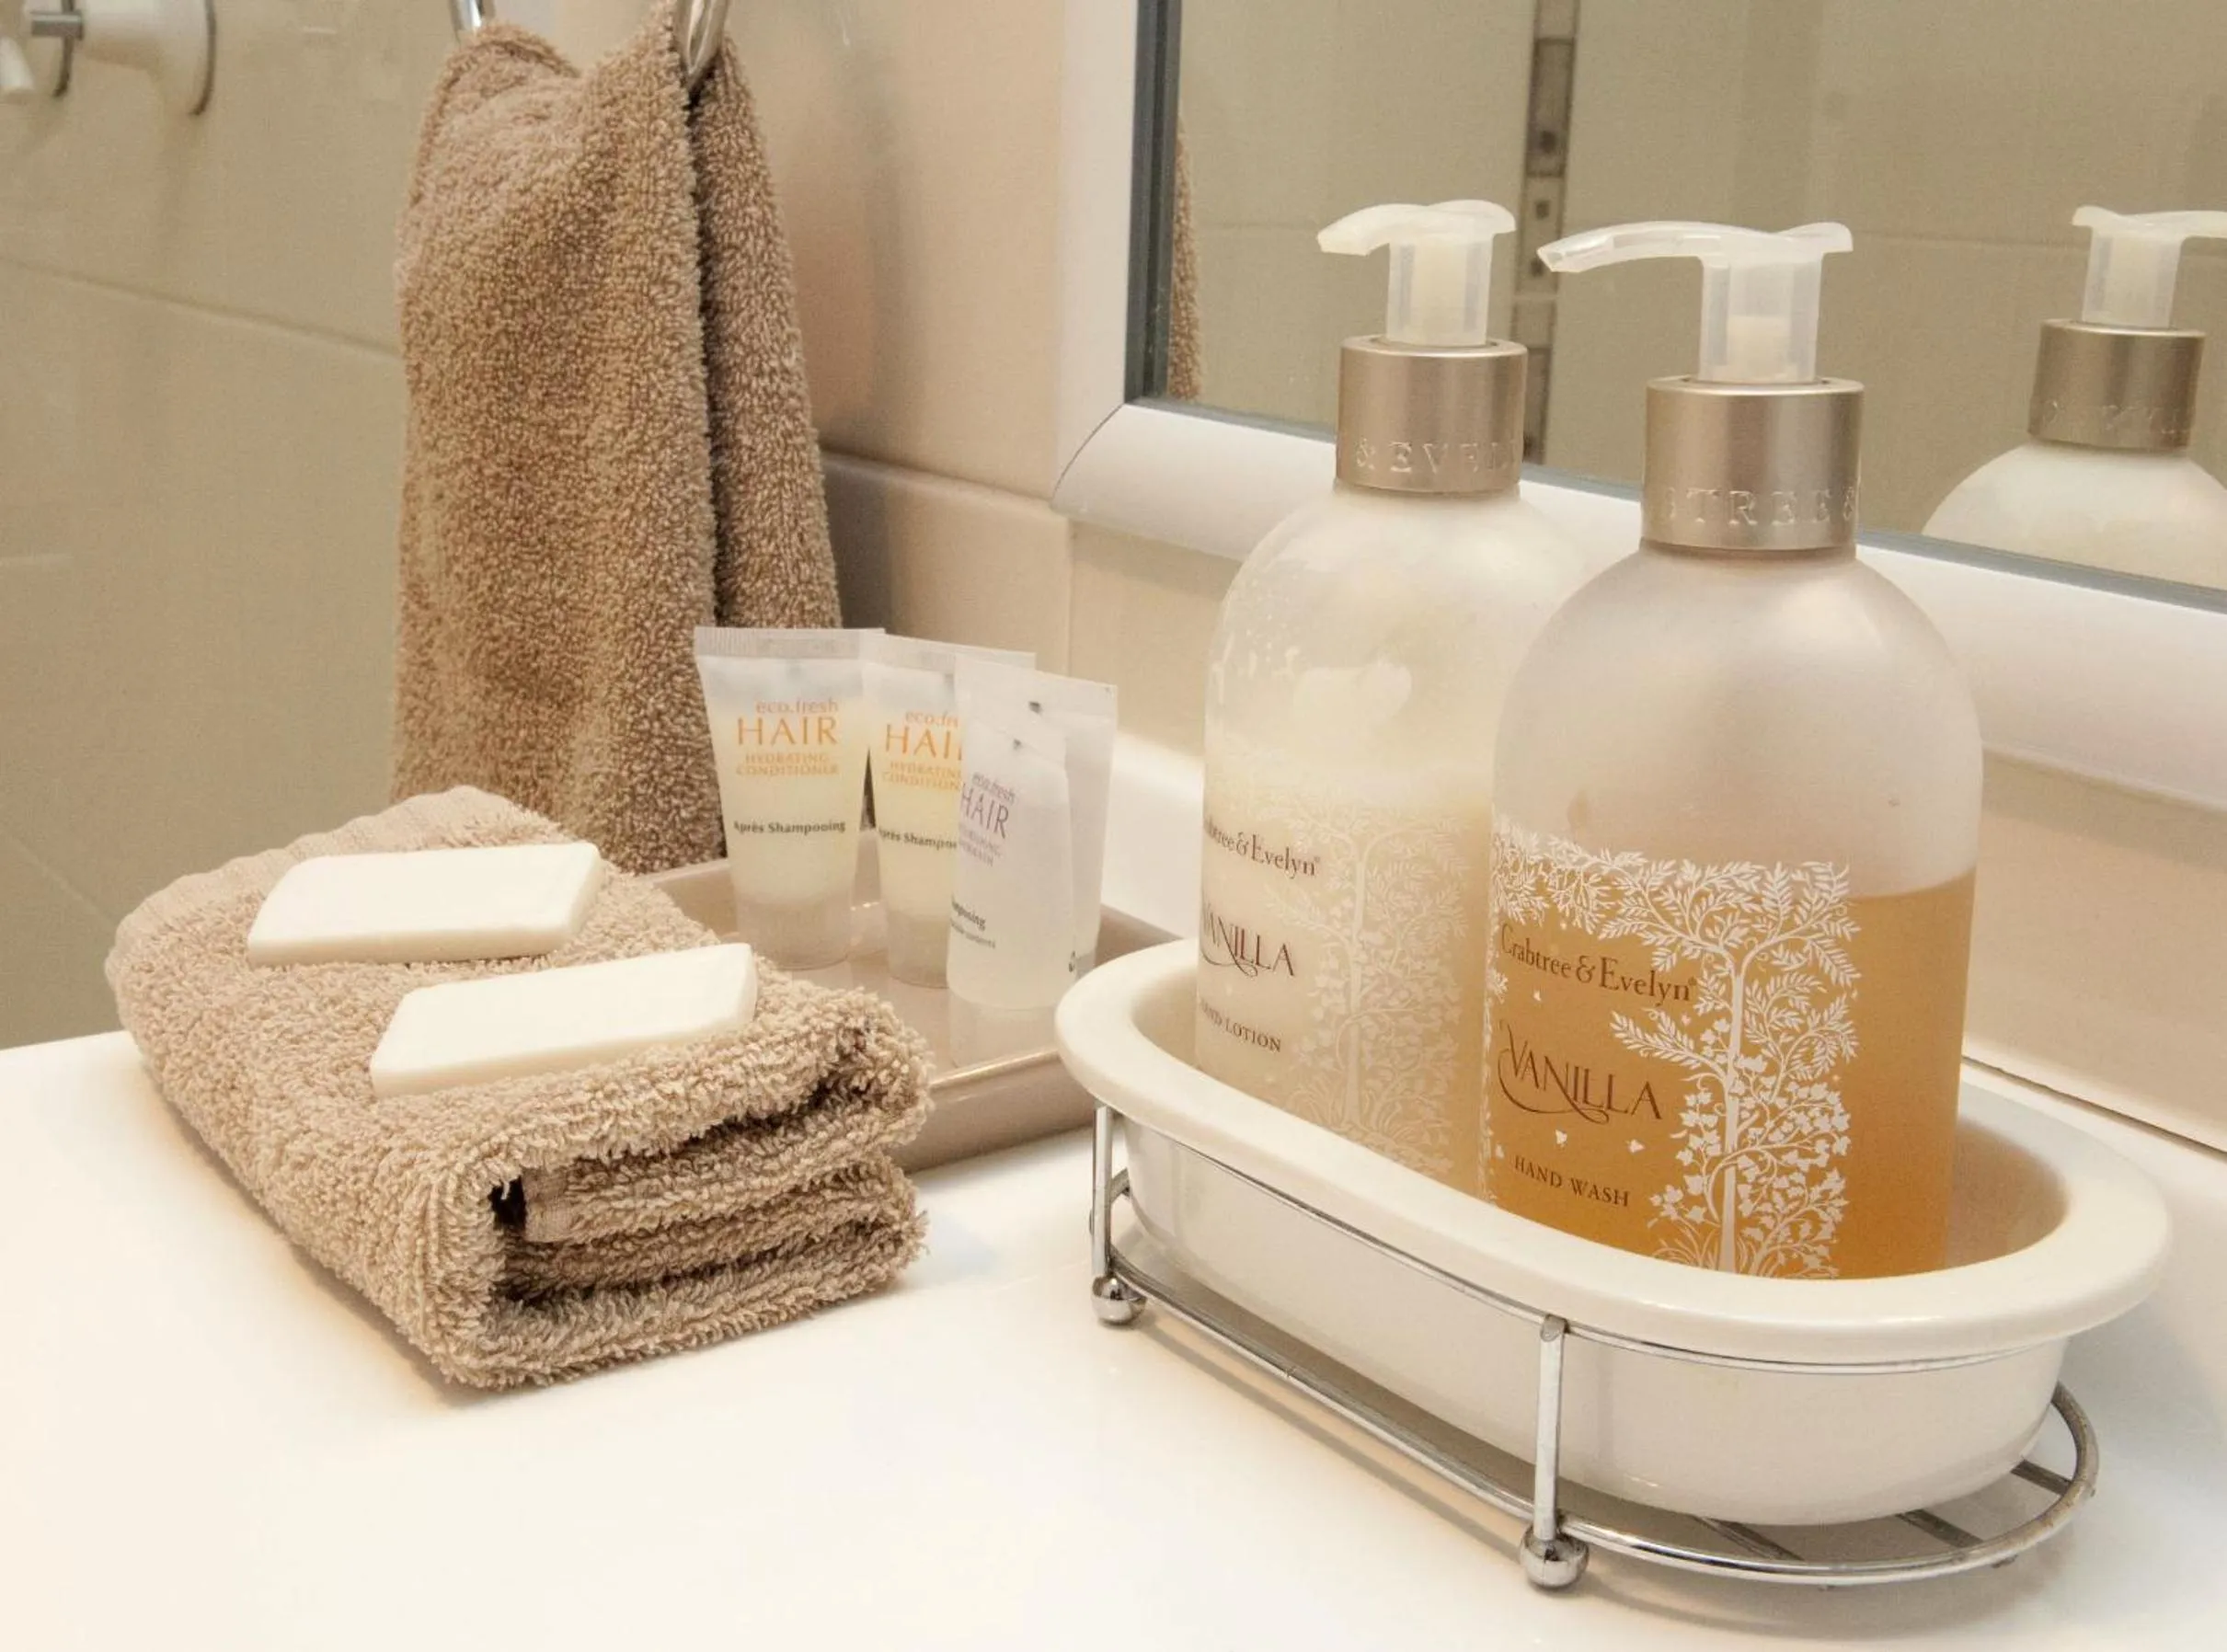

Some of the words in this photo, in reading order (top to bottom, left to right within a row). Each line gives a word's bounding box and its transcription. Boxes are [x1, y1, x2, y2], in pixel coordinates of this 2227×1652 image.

[738, 717, 838, 746] HAIR
[885, 723, 962, 761] HAI
[745, 752, 829, 764] HYDRATING
[768, 820, 846, 836] Shampooing
[959, 782, 1009, 839] HAIR
[1236, 831, 1249, 856] &
[1501, 923, 1572, 979] Crabtree
[1575, 954, 1597, 984] &
[1225, 1017, 1280, 1053] LOTION
[1498, 1017, 1663, 1125] VANILLA
[1514, 1154, 1563, 1188] HAND
[1570, 1176, 1629, 1208] WASH
